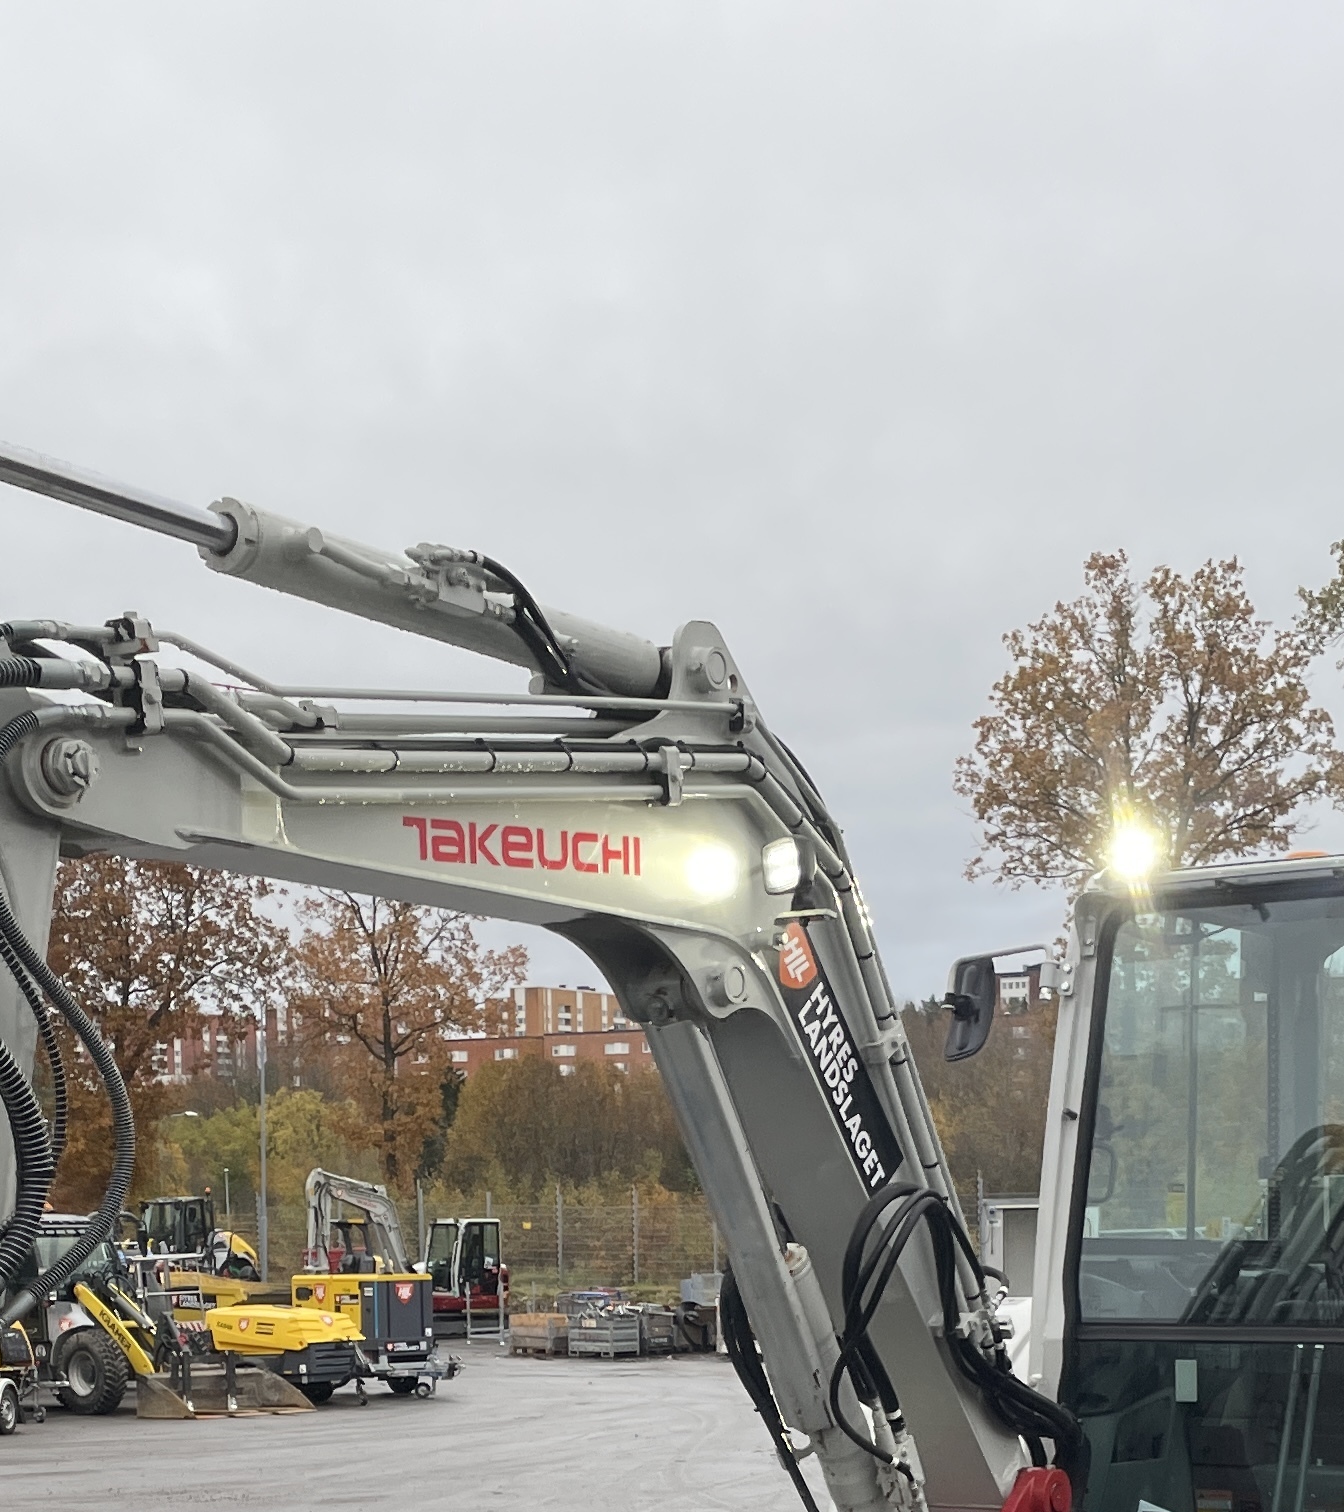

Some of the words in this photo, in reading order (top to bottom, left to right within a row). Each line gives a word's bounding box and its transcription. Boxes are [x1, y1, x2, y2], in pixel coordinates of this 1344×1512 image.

[403, 815, 641, 876] TAKEUCHI
[810, 981, 859, 1083] HYRES
[797, 999, 886, 1188] LANDSLAGET
[99, 1309, 132, 1351] KRAMER
